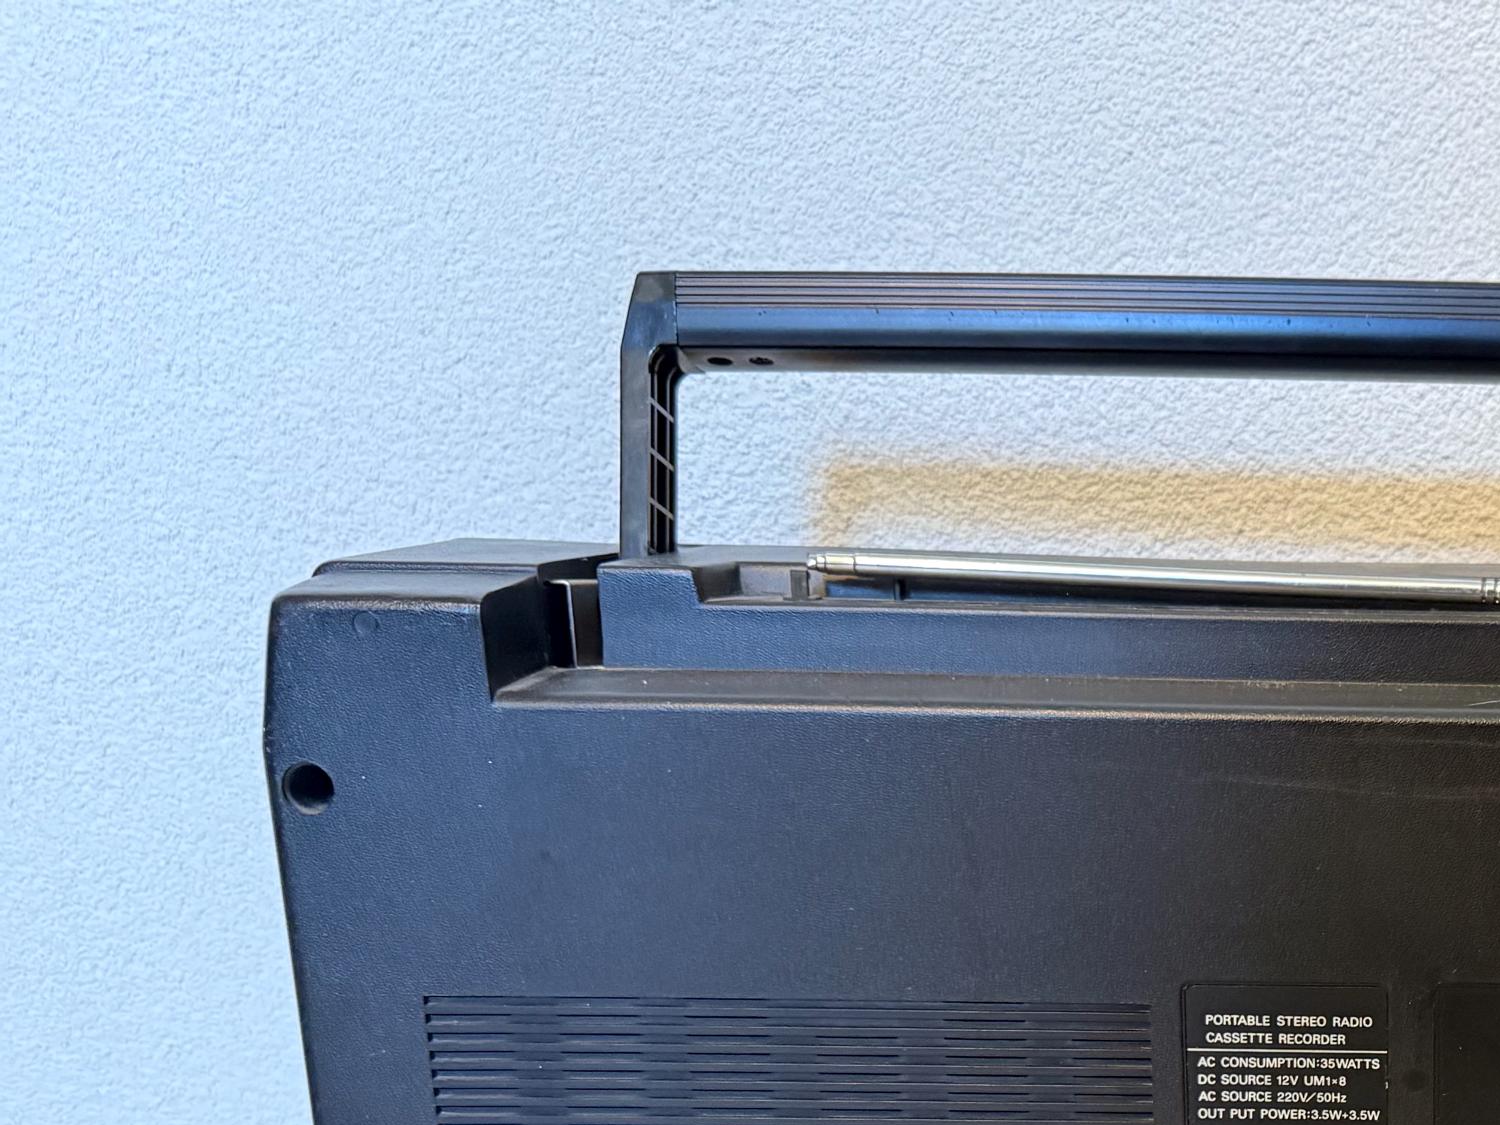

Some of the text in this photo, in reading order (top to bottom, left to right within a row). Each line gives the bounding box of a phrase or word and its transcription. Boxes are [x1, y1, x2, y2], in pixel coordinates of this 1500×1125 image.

[1205, 1014, 1373, 1028] PORTABLE STEREO RADIO
[1205, 1032, 1346, 1045] CASSETTE RECORDER
[1197, 1056, 1216, 1068] AC
[1197, 1074, 1216, 1085] DC
[1221, 1074, 1272, 1086] SOURCE
[1276, 1075, 1299, 1086] 12V
[1198, 1091, 1347, 1103] AC SOURCE 220V/50Hz
[1197, 1108, 1225, 1120] OUT
[1230, 1108, 1256, 1120] PUT
